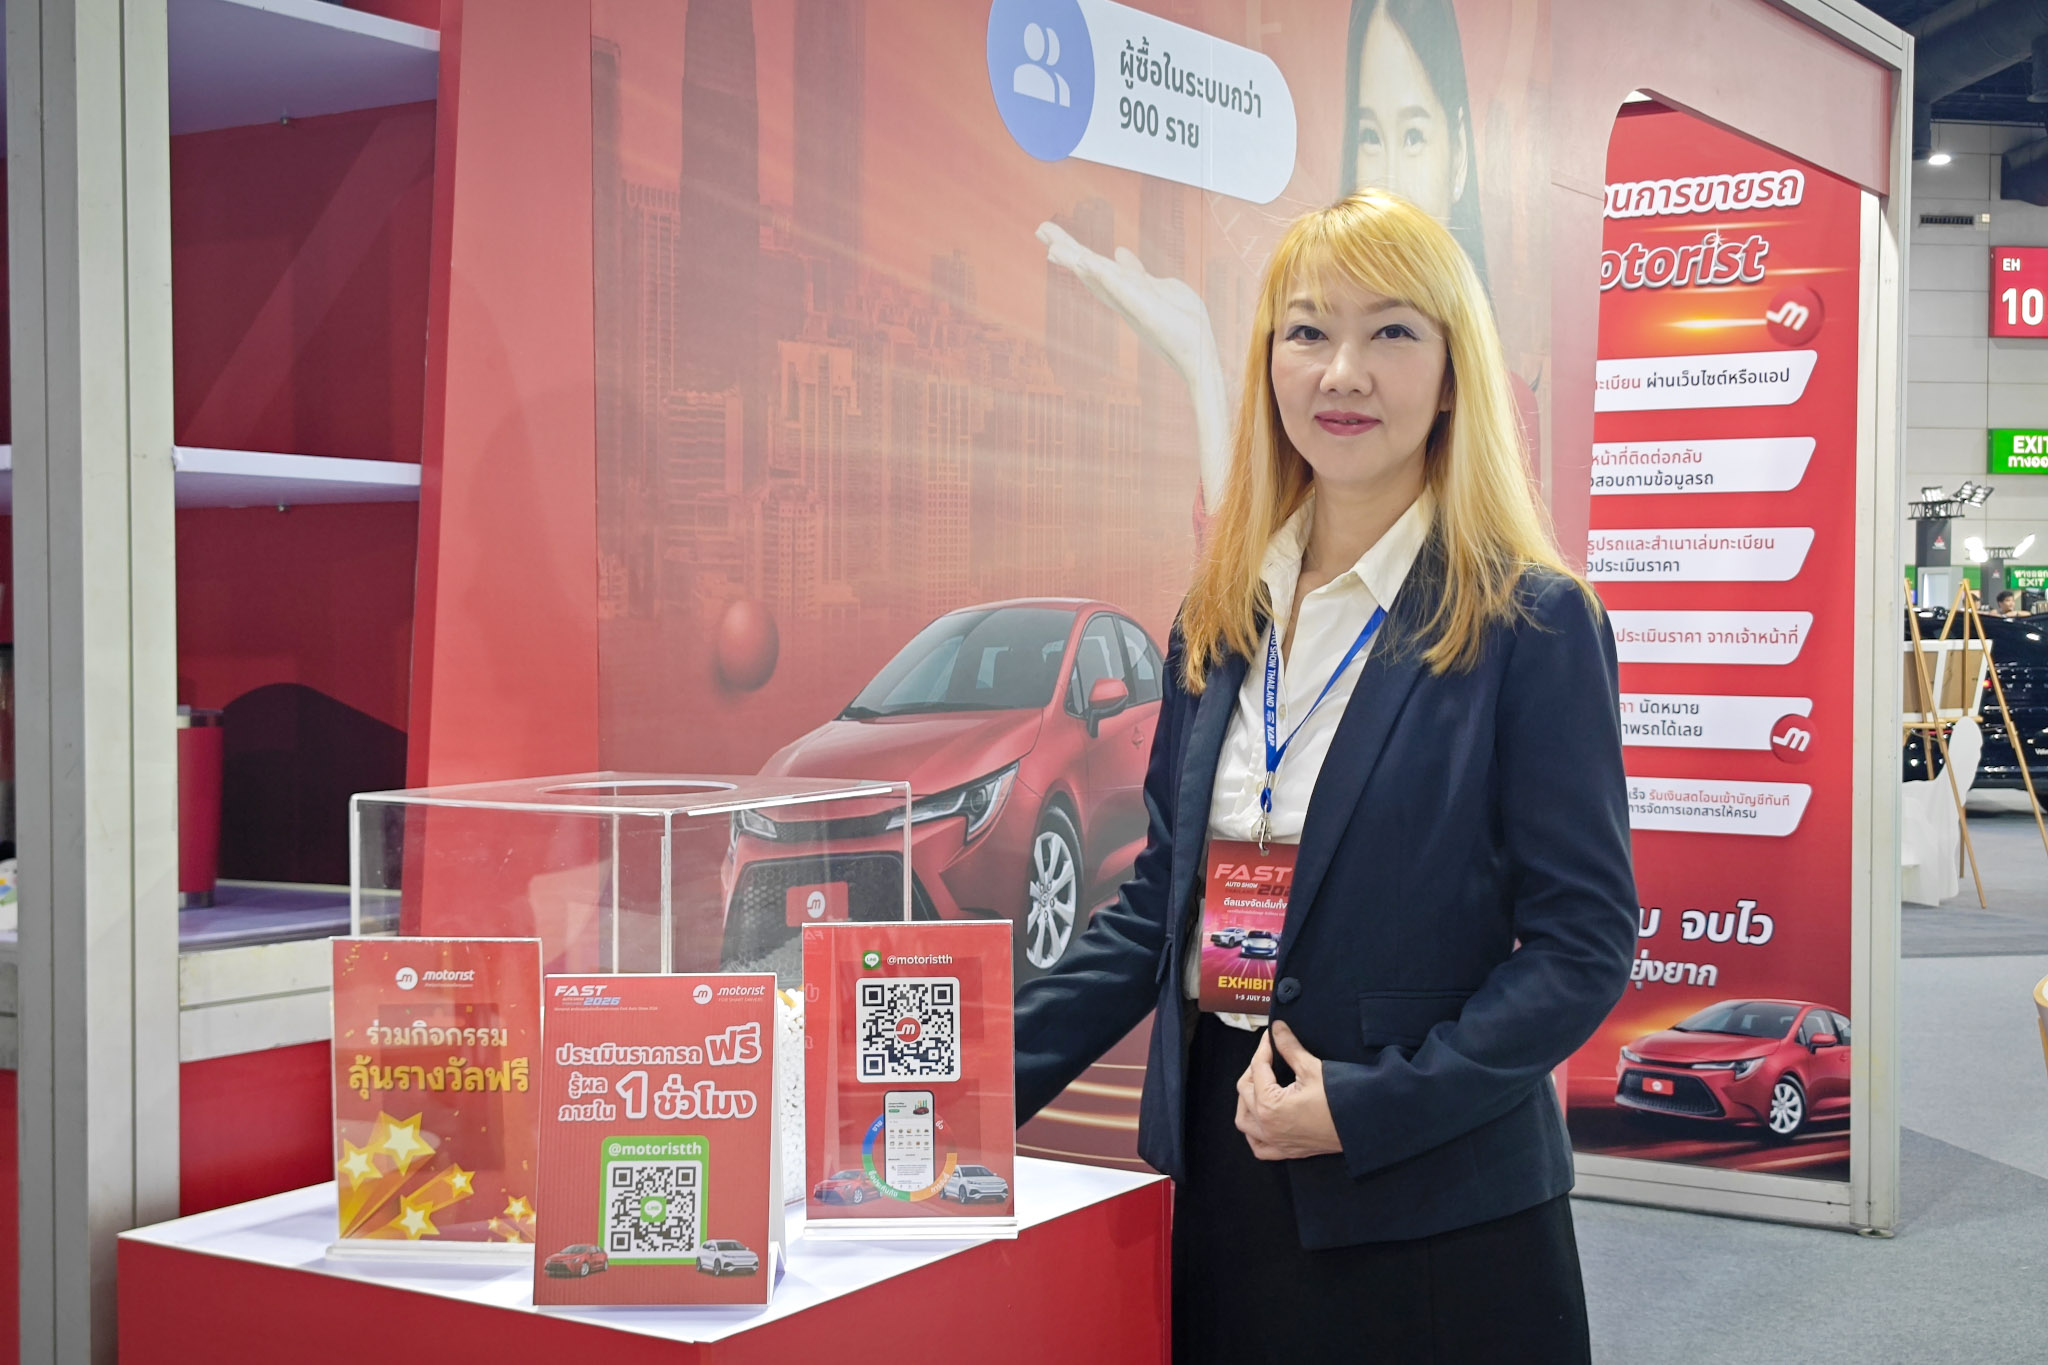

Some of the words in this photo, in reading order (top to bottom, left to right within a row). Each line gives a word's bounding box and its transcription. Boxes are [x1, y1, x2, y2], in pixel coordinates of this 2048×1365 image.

[1119, 36, 1262, 118] ผู้ซื้อในระบบกว่า
[1119, 97, 1159, 137] 900
[1166, 117, 1200, 148] ราย
[2002, 257, 2021, 271] EH
[2001, 287, 2044, 325] 10
[1646, 367, 1790, 388] ผ่านเว็บไซต์หรือแอป
[2018, 578, 2045, 587] EXIT
[1616, 628, 1702, 643] ประเมินราคา
[1707, 625, 1798, 644] จากเจ้าหน้าที่
[1266, 669, 1276, 707] THAILAND
[1639, 699, 1699, 715] นัดหมาย
[1649, 789, 1790, 808] รับเงินสดโอนเข้าบัญชีทันที
[1214, 863, 1293, 883] FAST
[1681, 899, 1775, 946] จบไว
[887, 953, 953, 965] @motoristth
[422, 969, 475, 981] motorist
[554, 985, 608, 997] FAST
[717, 985, 765, 996] motorist
[583, 997, 621, 1006] 2026
[366, 1019, 508, 1047] ร่วมกิจกรรม
[556, 1042, 703, 1066] ประเมินราคารถ
[705, 1021, 762, 1066] ฟรี
[349, 1054, 530, 1101] ลุ้นรางวัลฟรี
[568, 1071, 608, 1099] รู้ผล
[615, 1070, 648, 1119] 1
[653, 1073, 758, 1120] ชั่วโมง
[558, 1098, 616, 1122] ภายใน
[608, 1142, 702, 1156] @motoristth
